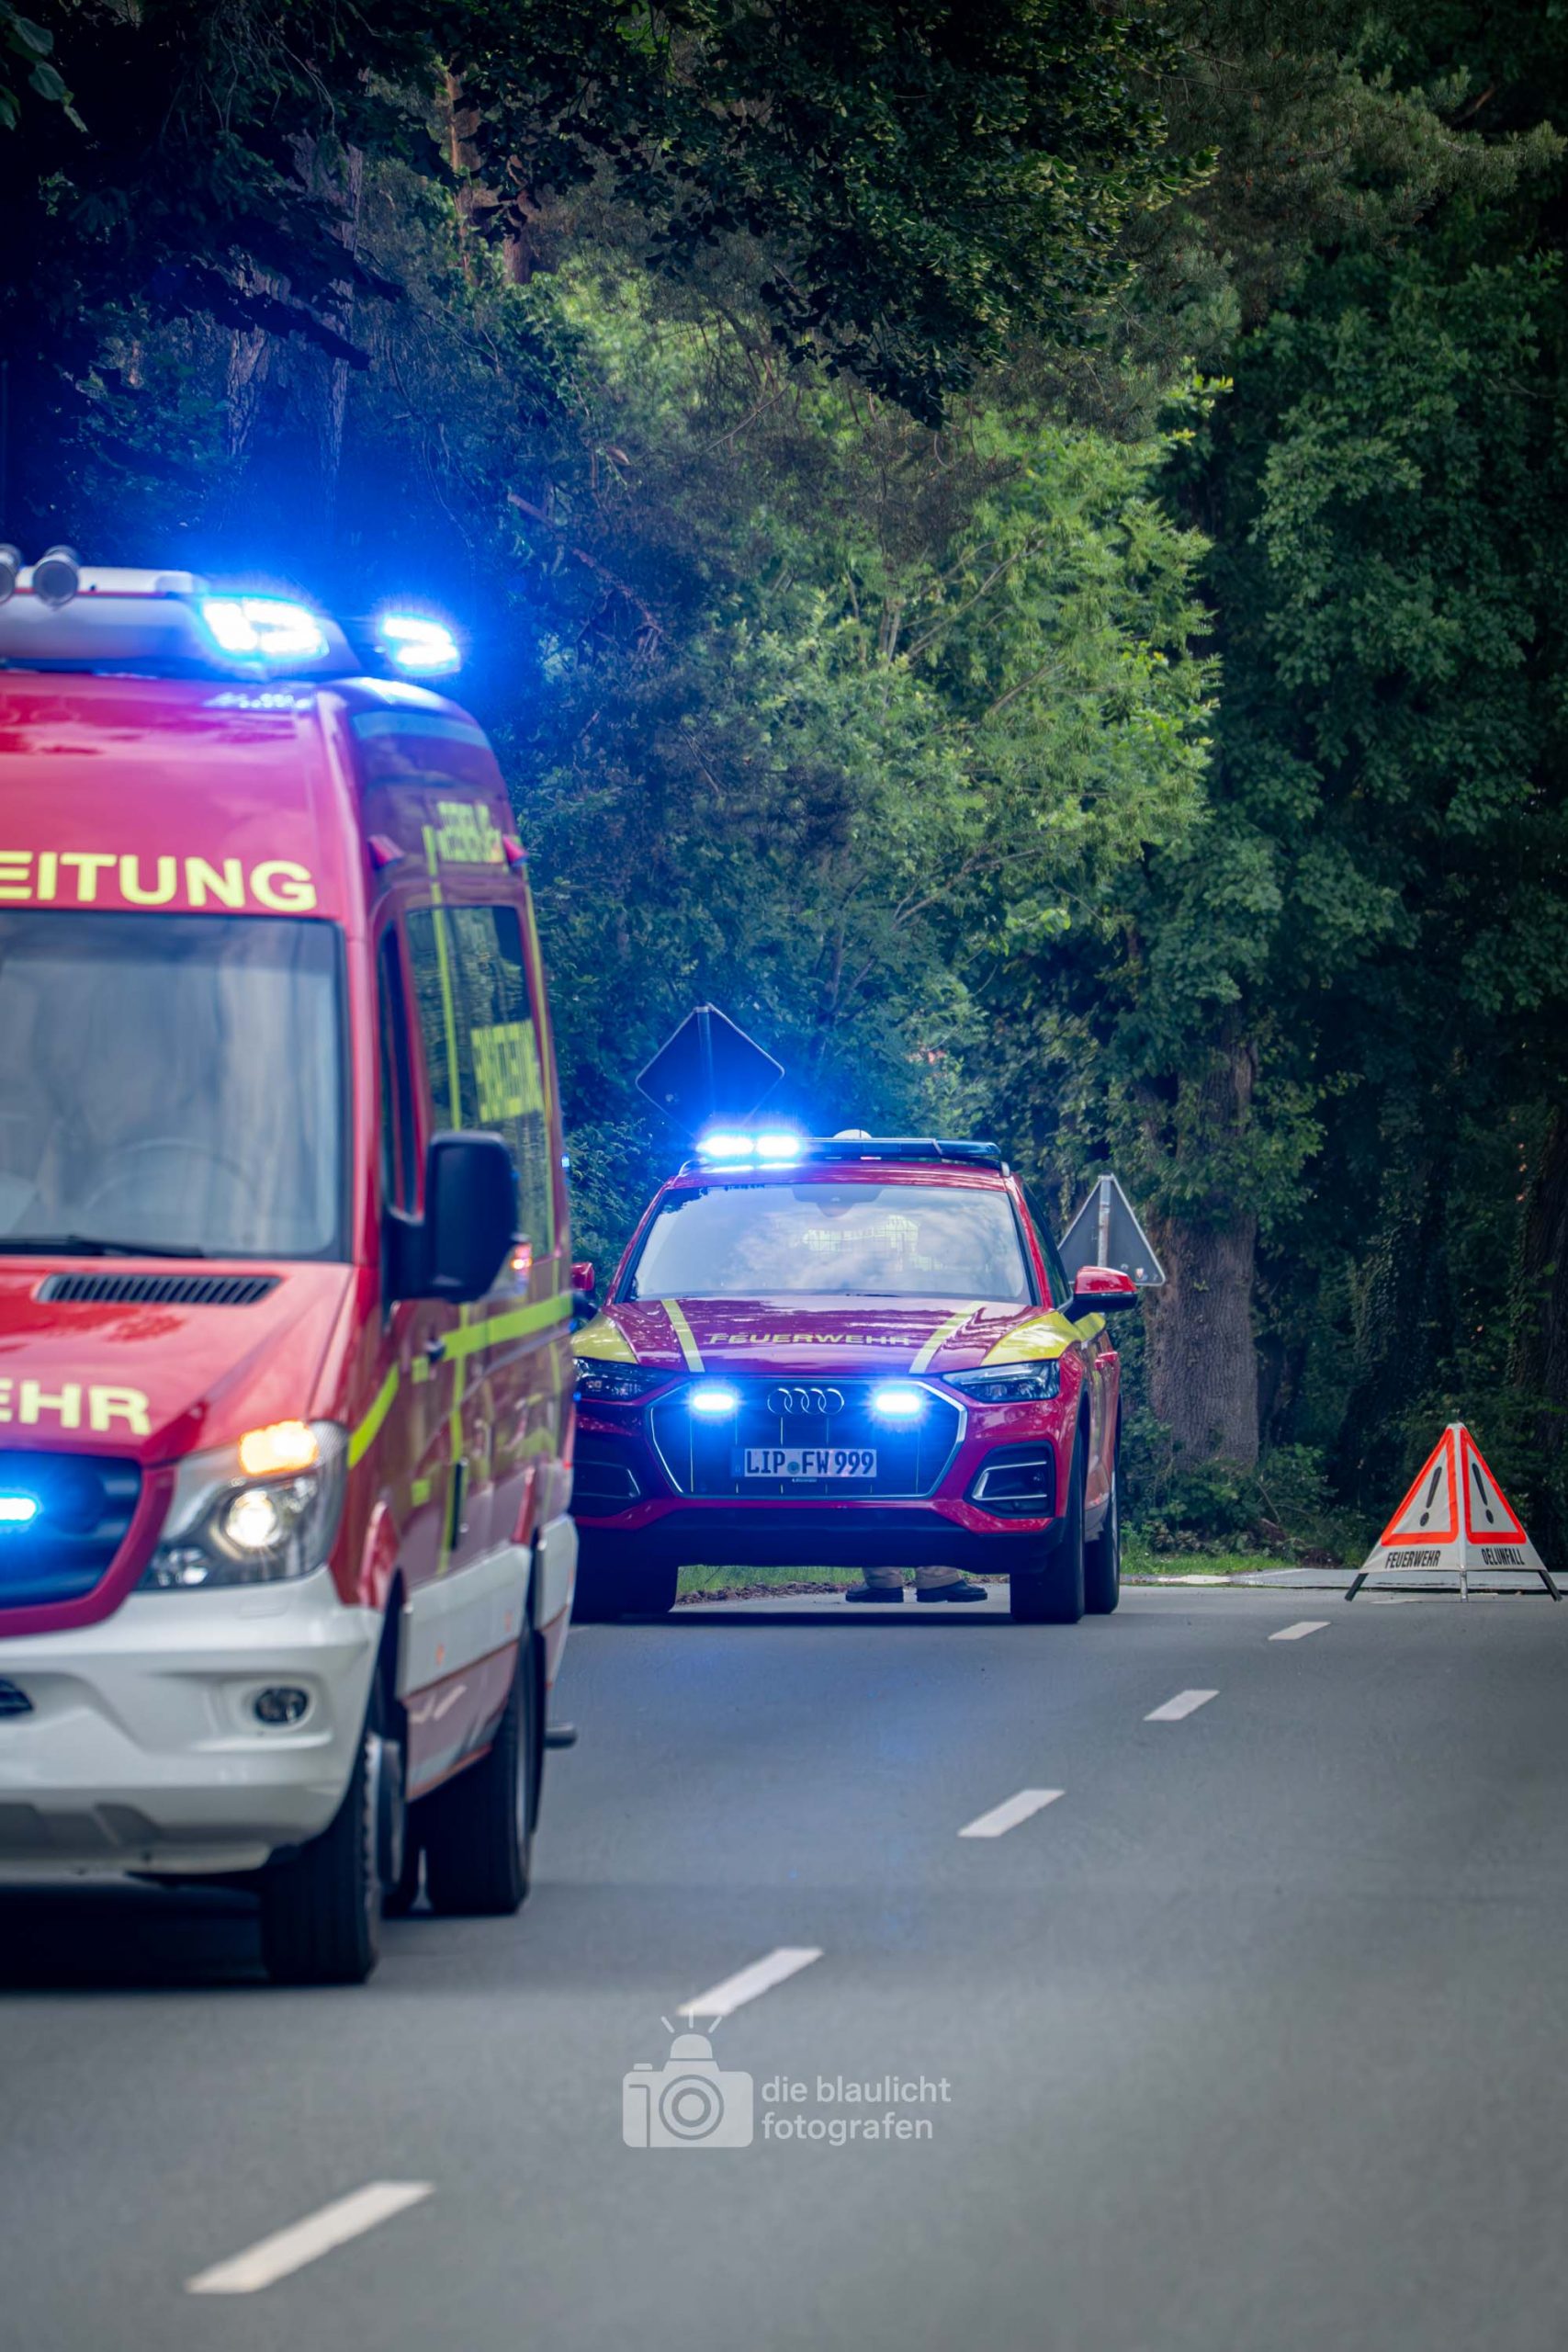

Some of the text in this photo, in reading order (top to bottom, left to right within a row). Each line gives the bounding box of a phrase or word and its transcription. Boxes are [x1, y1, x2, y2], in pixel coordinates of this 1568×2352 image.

[708, 1332, 911, 1346] FEUERWEHR
[0, 1378, 152, 1437] HR
[746, 1450, 785, 1474] LIP
[834, 1450, 874, 1475] 999
[1385, 1550, 1441, 1569] FEUERWEHR
[1481, 1547, 1526, 1566] OELUNFALL
